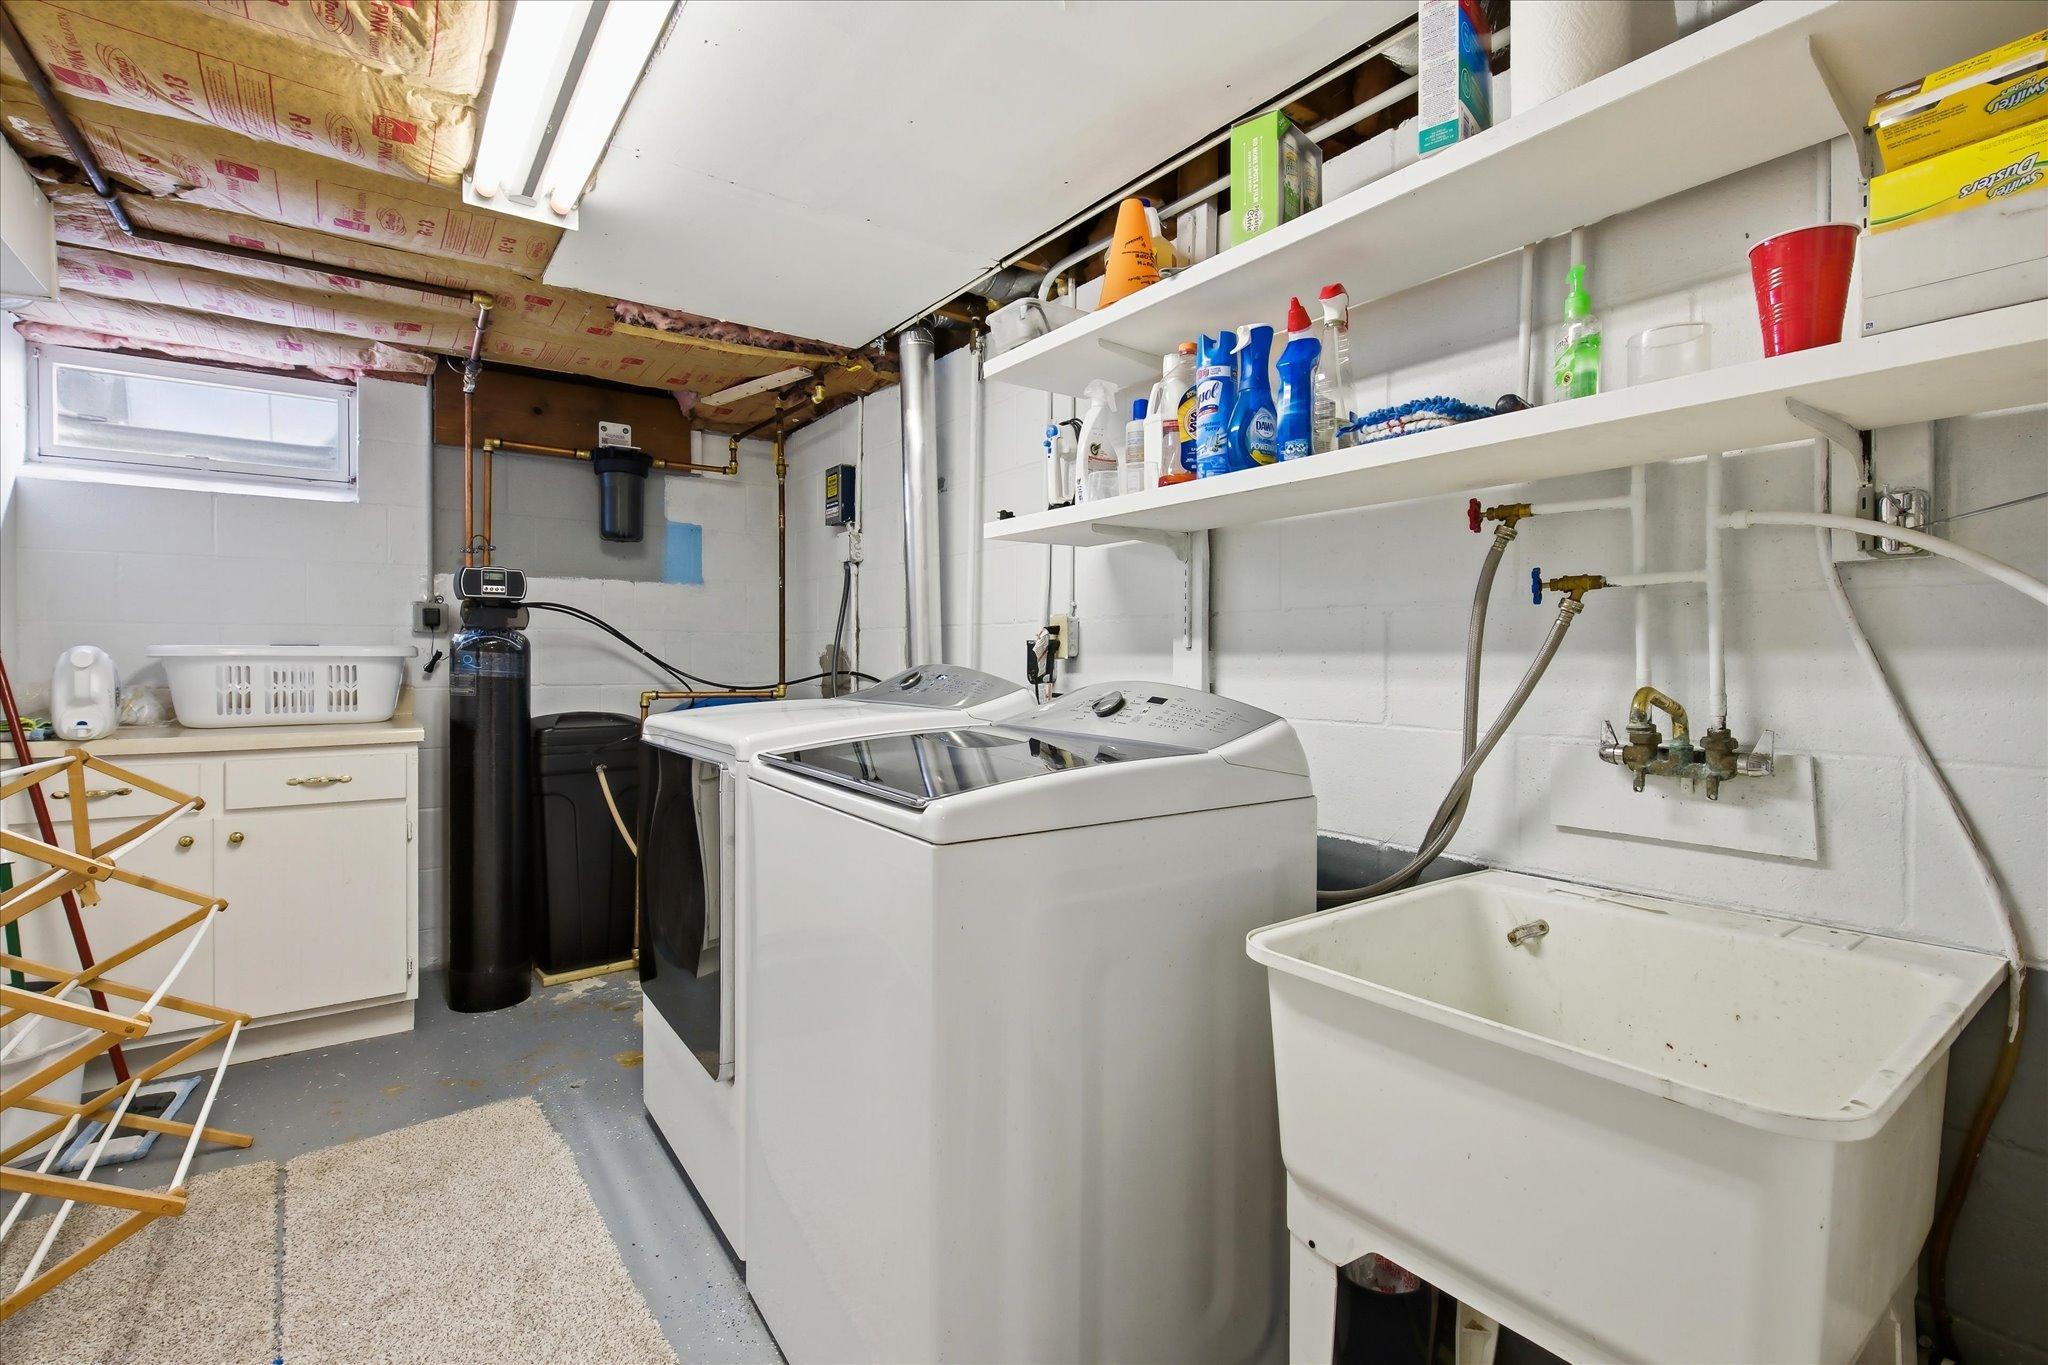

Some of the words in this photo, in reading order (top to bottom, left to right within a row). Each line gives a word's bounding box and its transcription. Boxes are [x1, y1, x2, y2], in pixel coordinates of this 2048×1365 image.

[370, 1, 390, 37] PINK
[161, 73, 195, 105] R-13
[1988, 76, 2048, 116] Swiffer
[288, 112, 314, 140] R-13
[1959, 152, 2040, 199] Dusters
[1989, 170, 2039, 200] Swiffer
